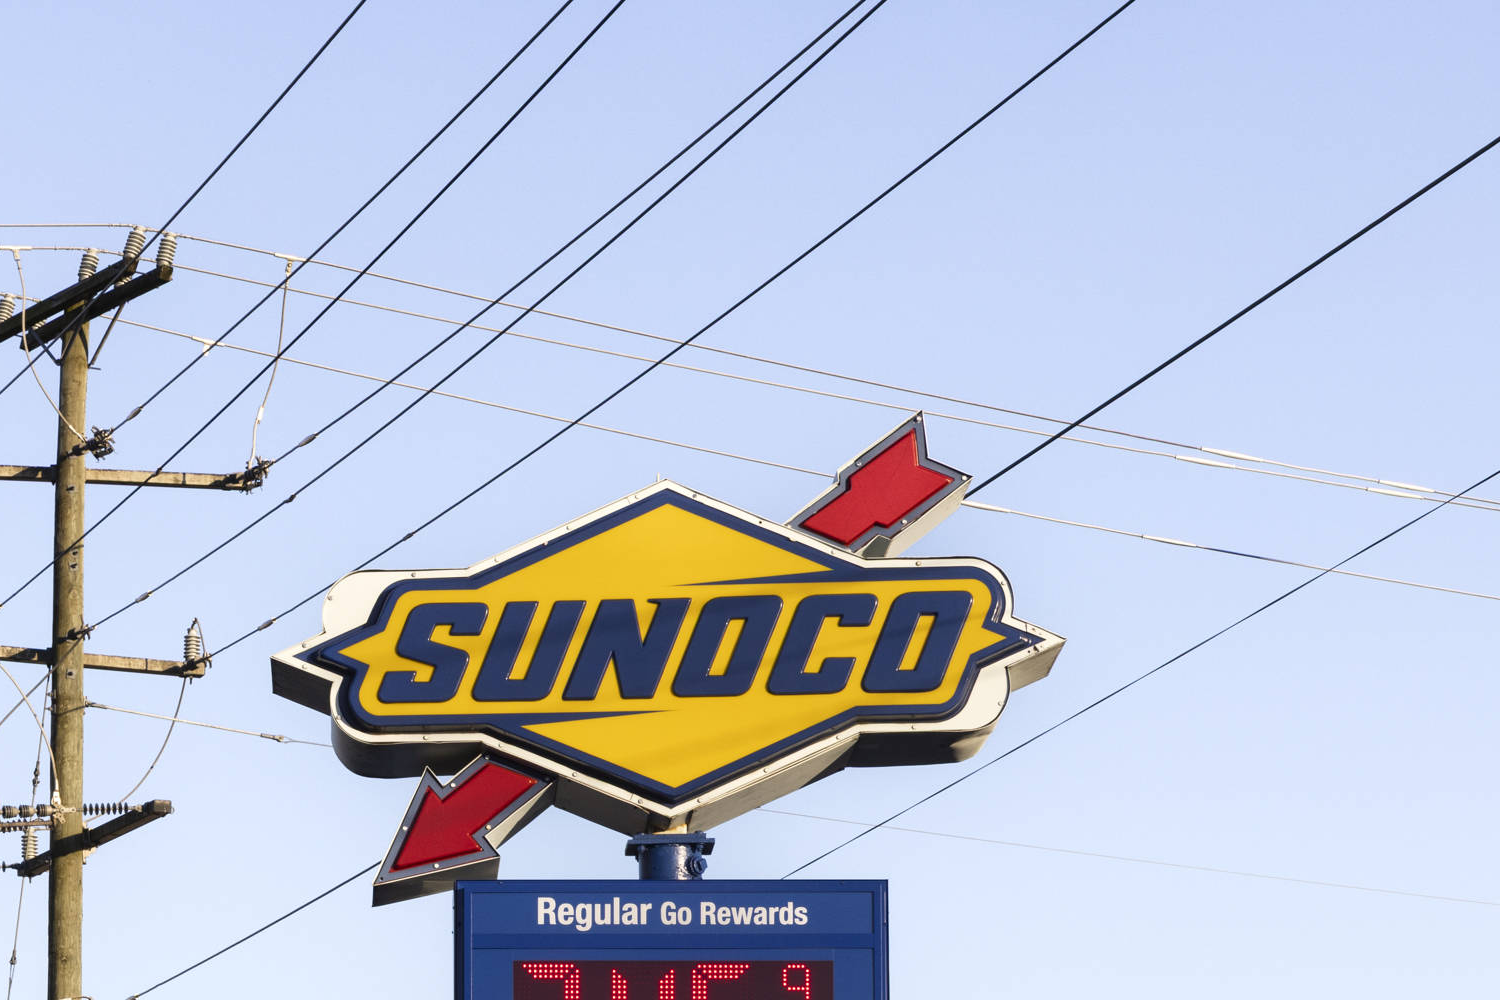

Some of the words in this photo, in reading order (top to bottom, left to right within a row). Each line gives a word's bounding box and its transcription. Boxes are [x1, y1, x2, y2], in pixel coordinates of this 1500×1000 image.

[376, 590, 975, 702] SUNOCO
[537, 896, 653, 932] Regular
[660, 901, 692, 925] Go
[700, 901, 809, 925] Rewards
